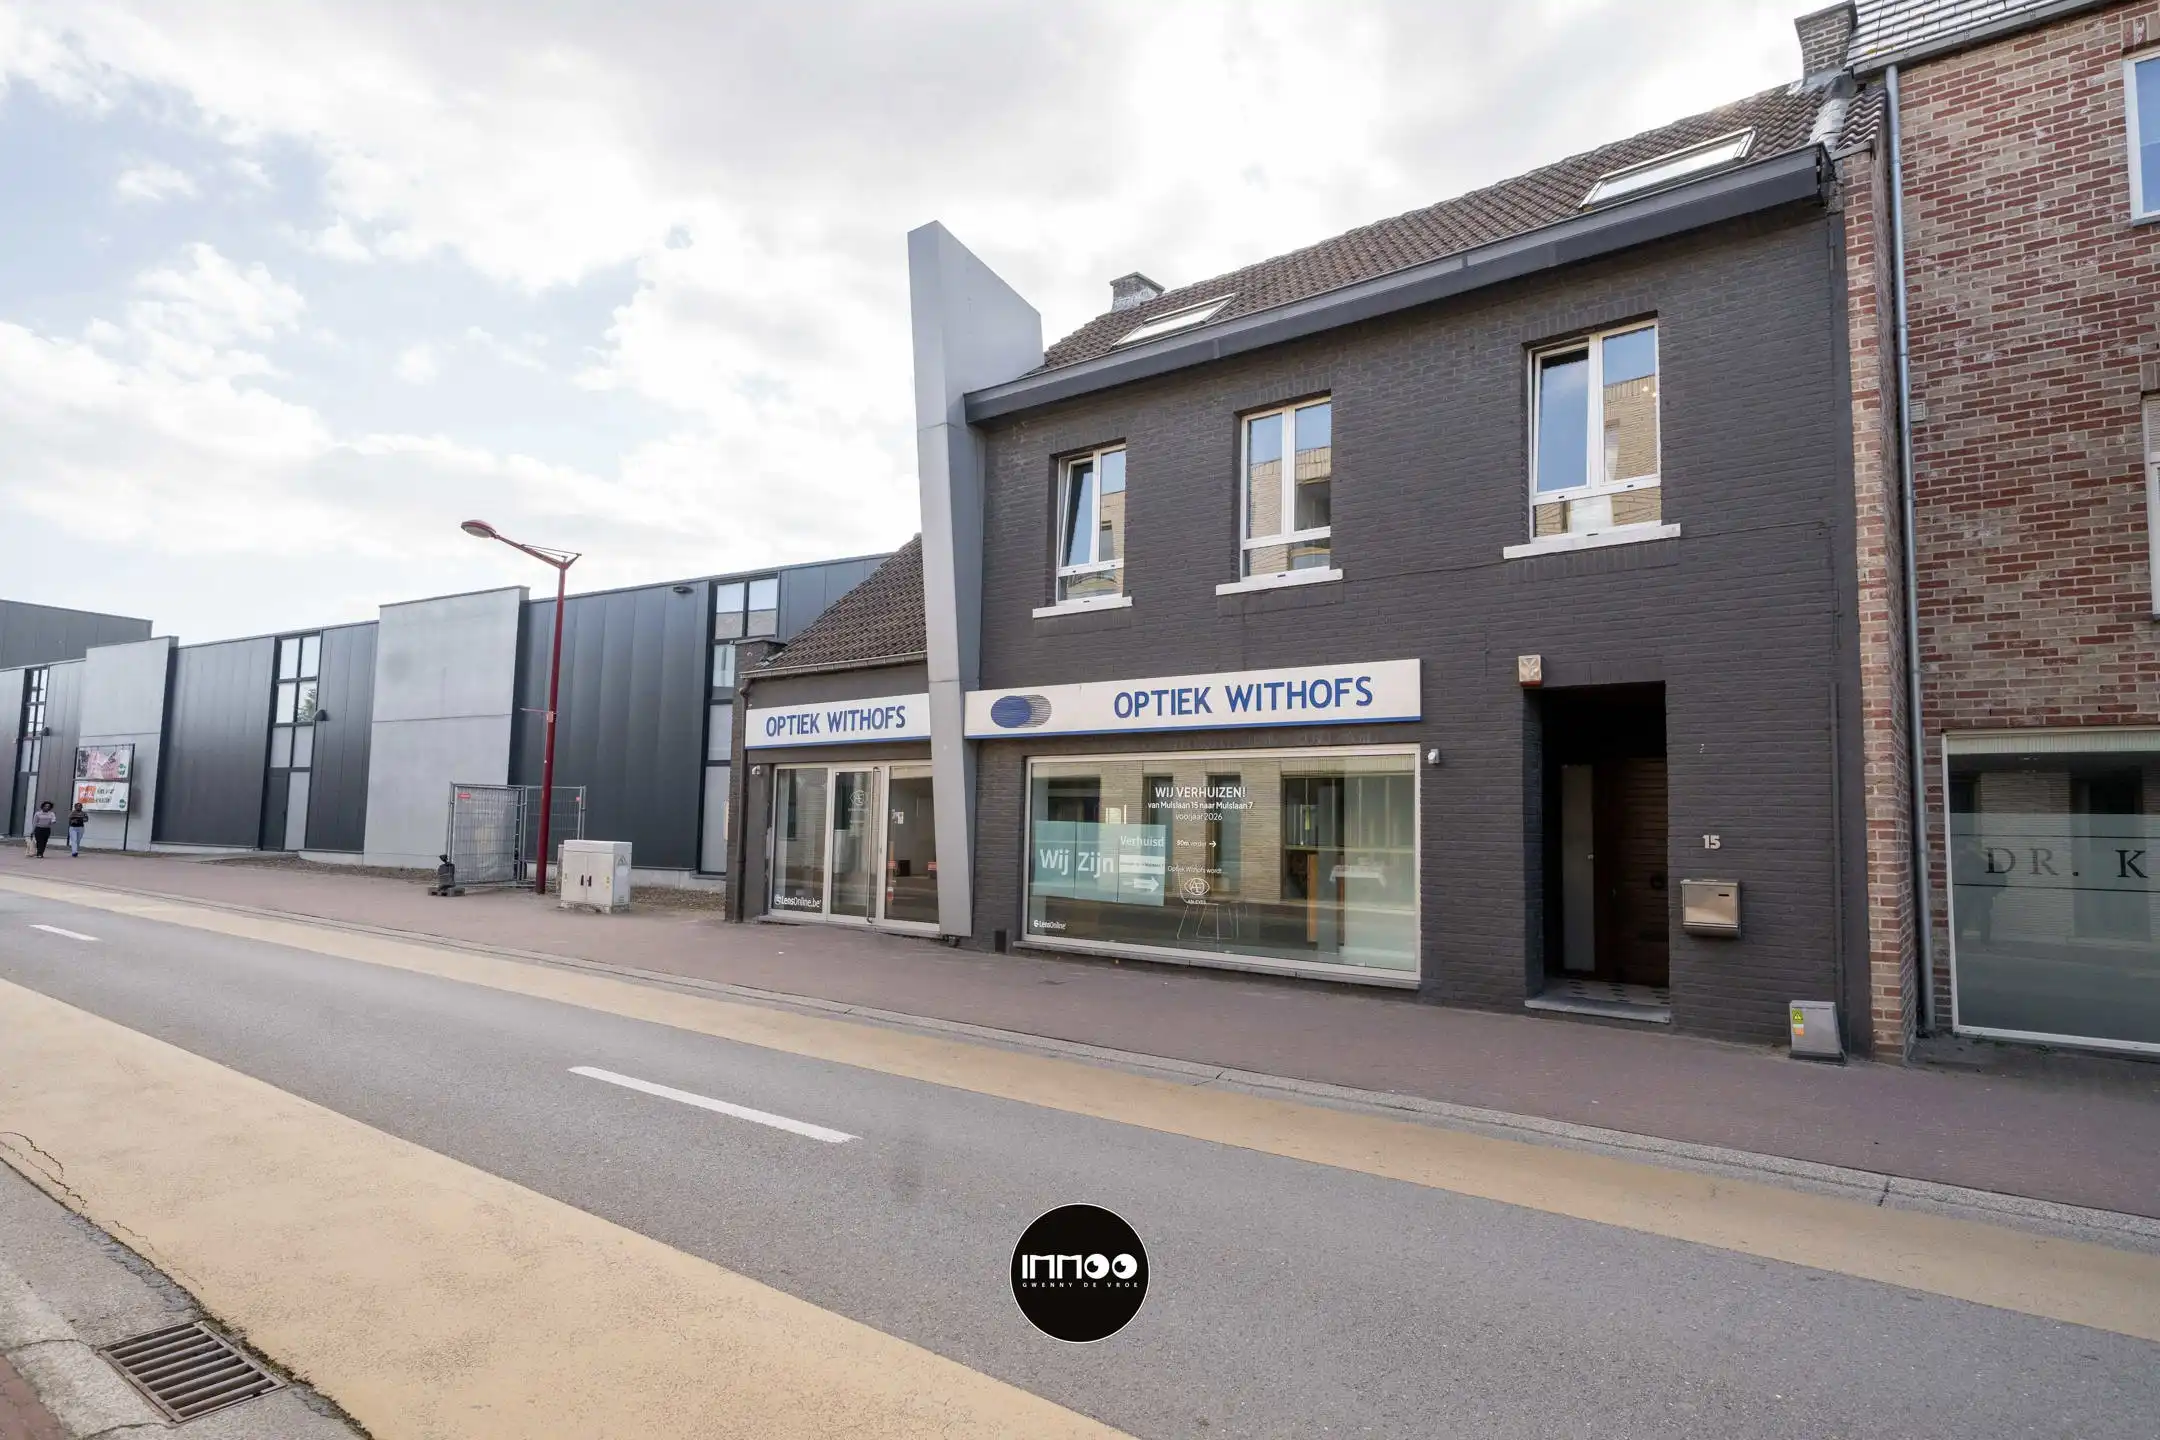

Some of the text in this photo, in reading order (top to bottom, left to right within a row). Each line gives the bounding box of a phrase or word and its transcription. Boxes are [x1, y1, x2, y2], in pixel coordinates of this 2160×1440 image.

[1114, 676, 1373, 719] OPTIEK WITHOFS
[766, 705, 906, 737] OPTIEK WITHOFS
[1155, 786, 1246, 798] WIJ VERHUIZEN!
[1120, 836, 1165, 847] Verhuisd
[1702, 834, 1721, 849] 15
[1040, 848, 1114, 879] Wij Zijn
[1984, 847, 2149, 879] DR. K
